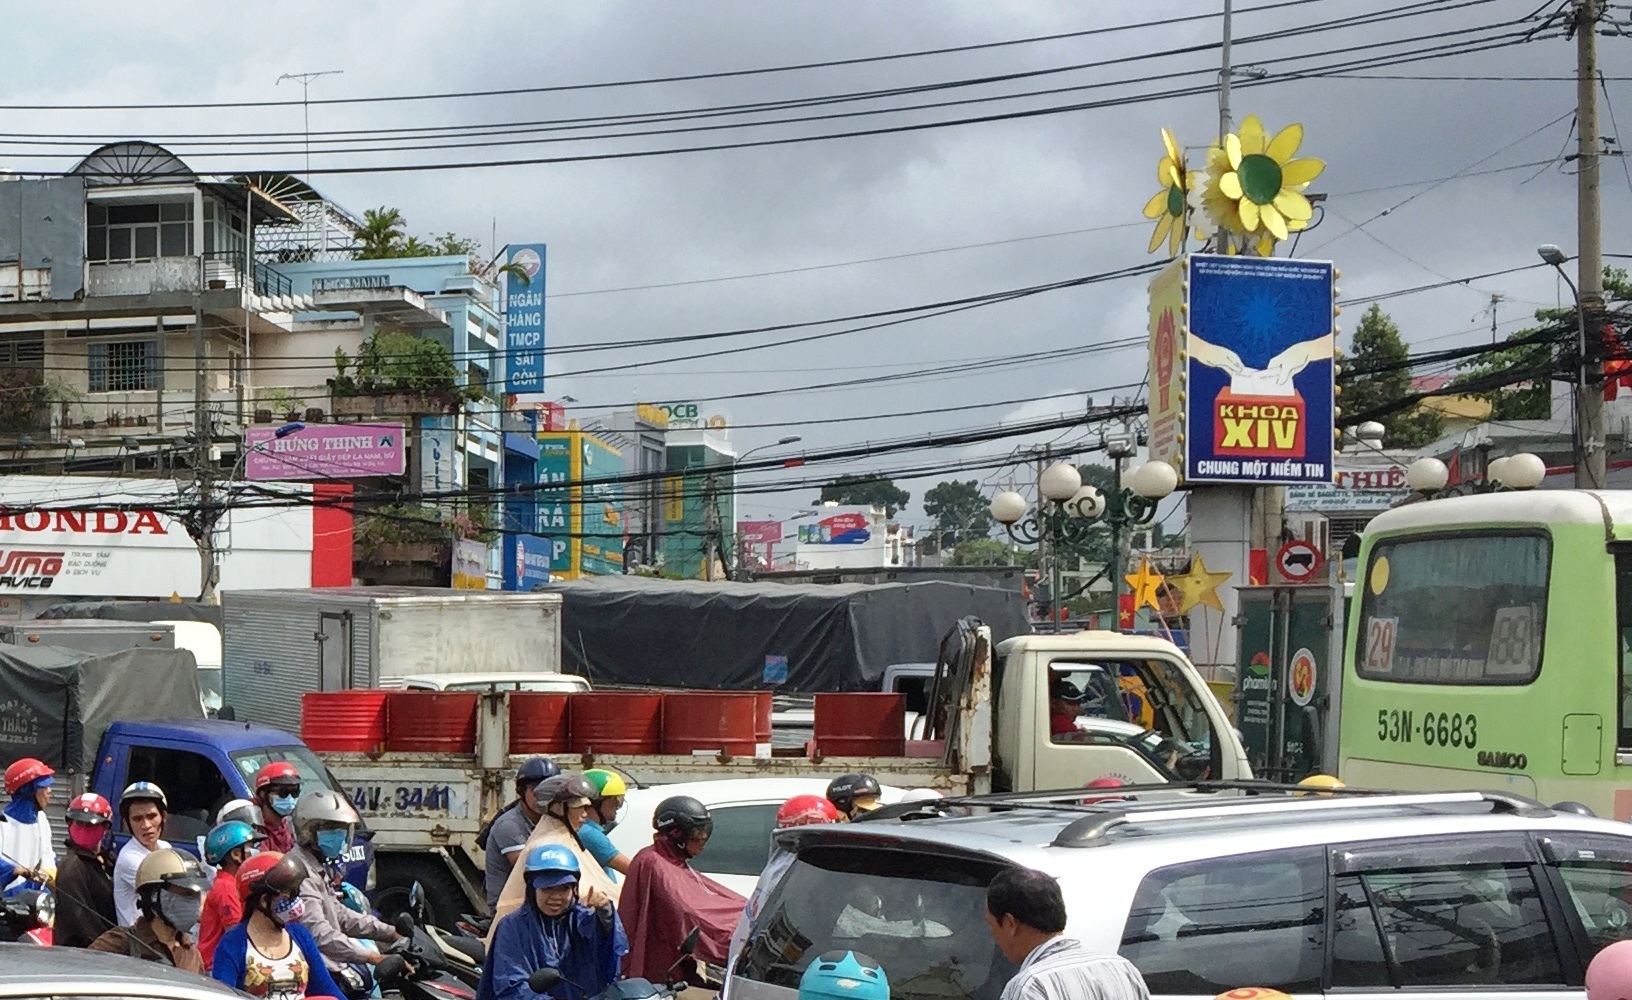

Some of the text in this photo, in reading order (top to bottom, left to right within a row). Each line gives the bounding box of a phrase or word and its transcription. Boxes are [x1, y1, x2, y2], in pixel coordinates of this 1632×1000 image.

[509, 290, 542, 307] NGÂN
[508, 311, 541, 327] HÀNG
[509, 332, 540, 346] TMCP
[1221, 418, 1297, 449] XIV
[274, 435, 320, 452] HƯNG
[322, 436, 374, 451] THỊNH
[1197, 460, 1239, 475] CHUNG
[1241, 460, 1268, 478] MỘT
[1304, 463, 1325, 478] TIN
[1369, 621, 1393, 668] 29
